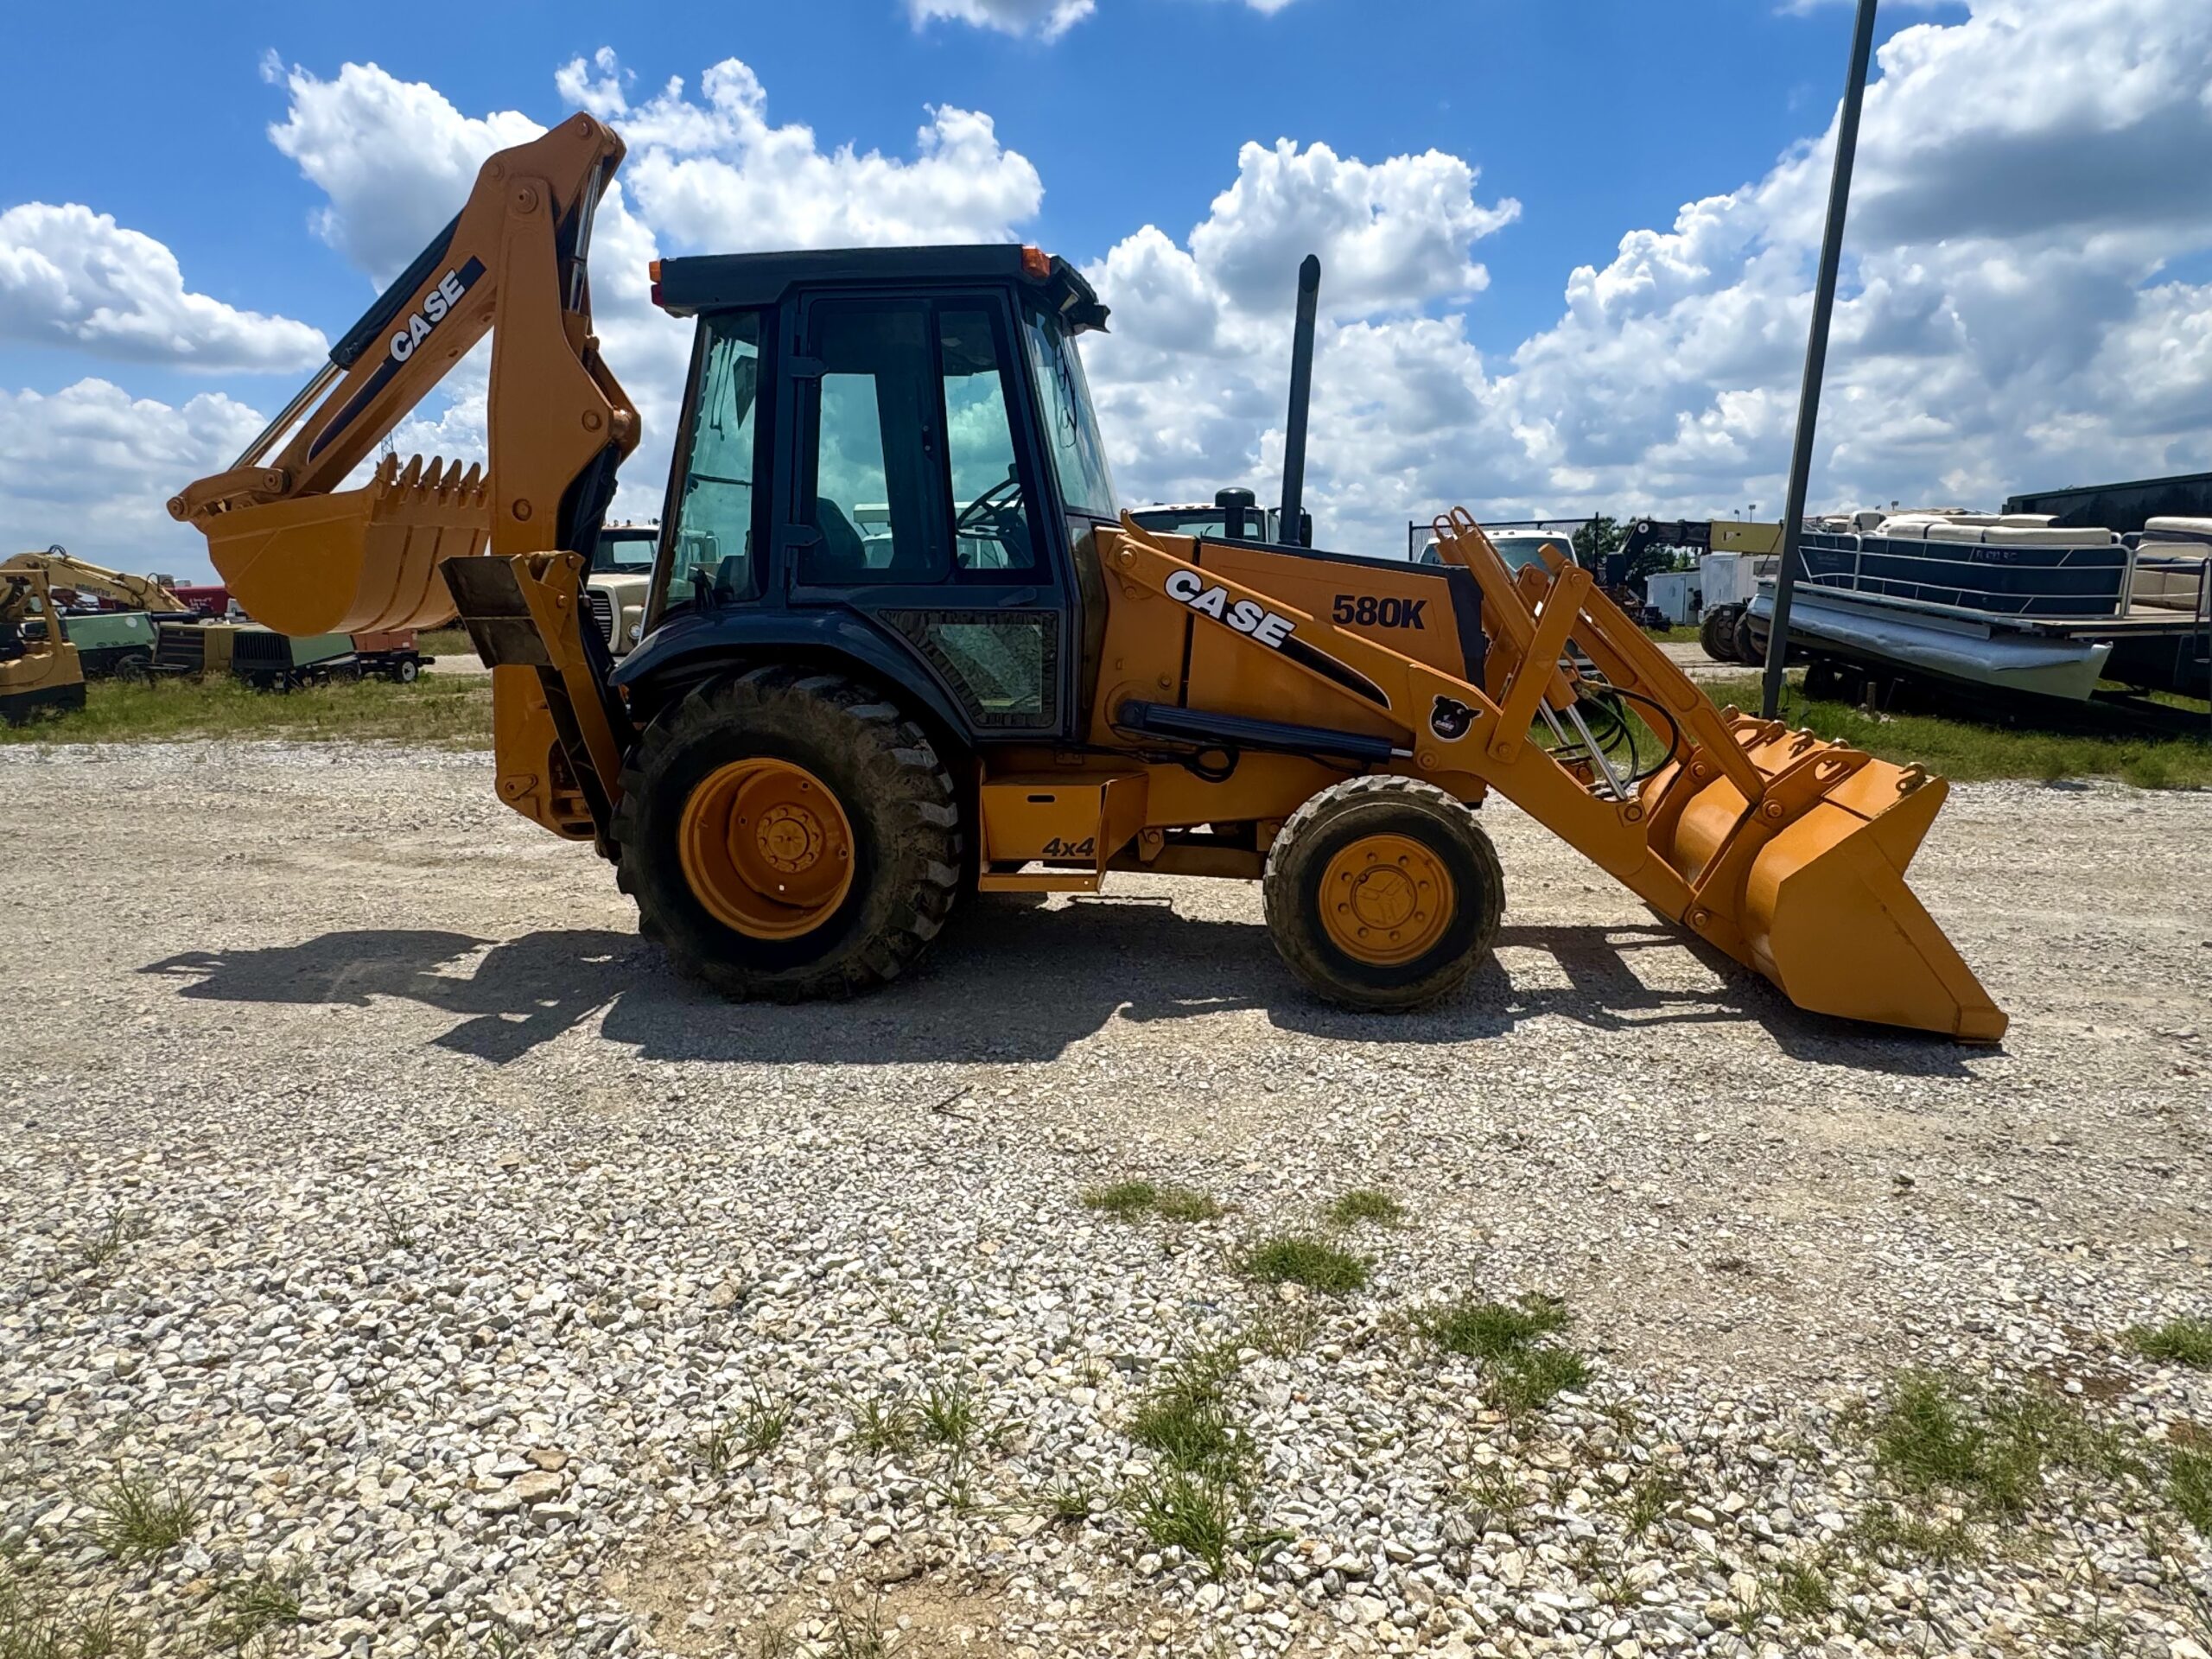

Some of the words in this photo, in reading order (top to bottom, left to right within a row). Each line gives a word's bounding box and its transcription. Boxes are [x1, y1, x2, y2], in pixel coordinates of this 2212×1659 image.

[390, 269, 466, 362] CASE
[1165, 569, 1297, 648] CASE
[1332, 594, 1427, 630] 580K
[1041, 836, 1096, 857] 4x4
